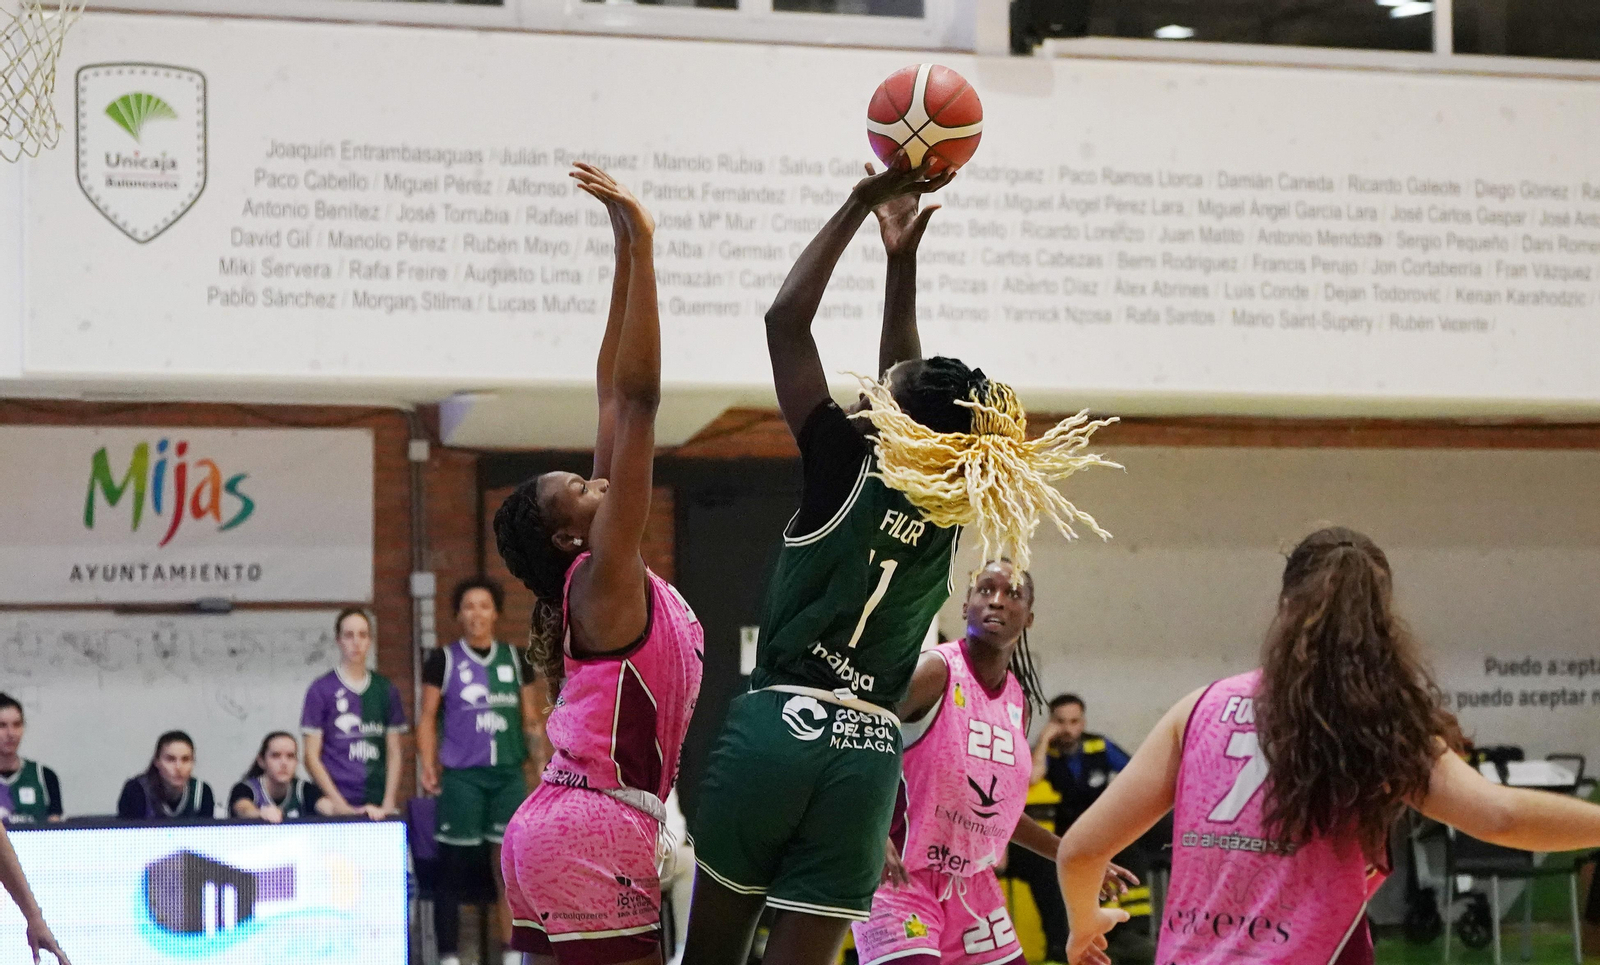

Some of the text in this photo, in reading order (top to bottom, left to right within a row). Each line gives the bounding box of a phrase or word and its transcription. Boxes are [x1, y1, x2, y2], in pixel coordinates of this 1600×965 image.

[105, 150, 178, 173] Unicaja
[266, 140, 334, 161] Joaquín
[341, 140, 484, 166] Entrambasaguas
[499, 143, 548, 166] Julián
[254, 168, 298, 188] Paco
[304, 169, 367, 192] Cabello
[383, 173, 438, 197] Miguel
[444, 174, 492, 195] Pérez
[506, 178, 567, 198] Alfonso
[242, 198, 308, 218] Antonio
[396, 204, 436, 223] José
[444, 204, 509, 224] Torrubia
[526, 206, 578, 226] Rafael
[230, 226, 280, 248] David
[286, 228, 310, 248] Gil
[328, 231, 391, 250] Manolo
[397, 231, 446, 252] Pérez
[463, 233, 517, 254] Rubén
[524, 236, 570, 260] Mayo
[218, 256, 253, 278] Miki
[261, 258, 331, 280] Servera
[349, 260, 390, 280] Rafa
[396, 262, 448, 282] Freire
[464, 263, 535, 286] Augusto
[540, 266, 581, 284] Lima
[207, 286, 256, 307] Pablo
[262, 287, 336, 310] Sánchez
[83, 438, 256, 548] Mijas
[69, 564, 263, 583] AYUNTAMIENTO
[1484, 655, 1543, 676] Puedo
[1456, 687, 1514, 711] puedo
[1519, 688, 1586, 711] aceptar
[829, 734, 896, 756] MÁLAGA
[832, 721, 894, 742] DEL SOL
[968, 718, 1016, 766] 22
[1206, 730, 1271, 824] 7
[962, 906, 1016, 954] 22
